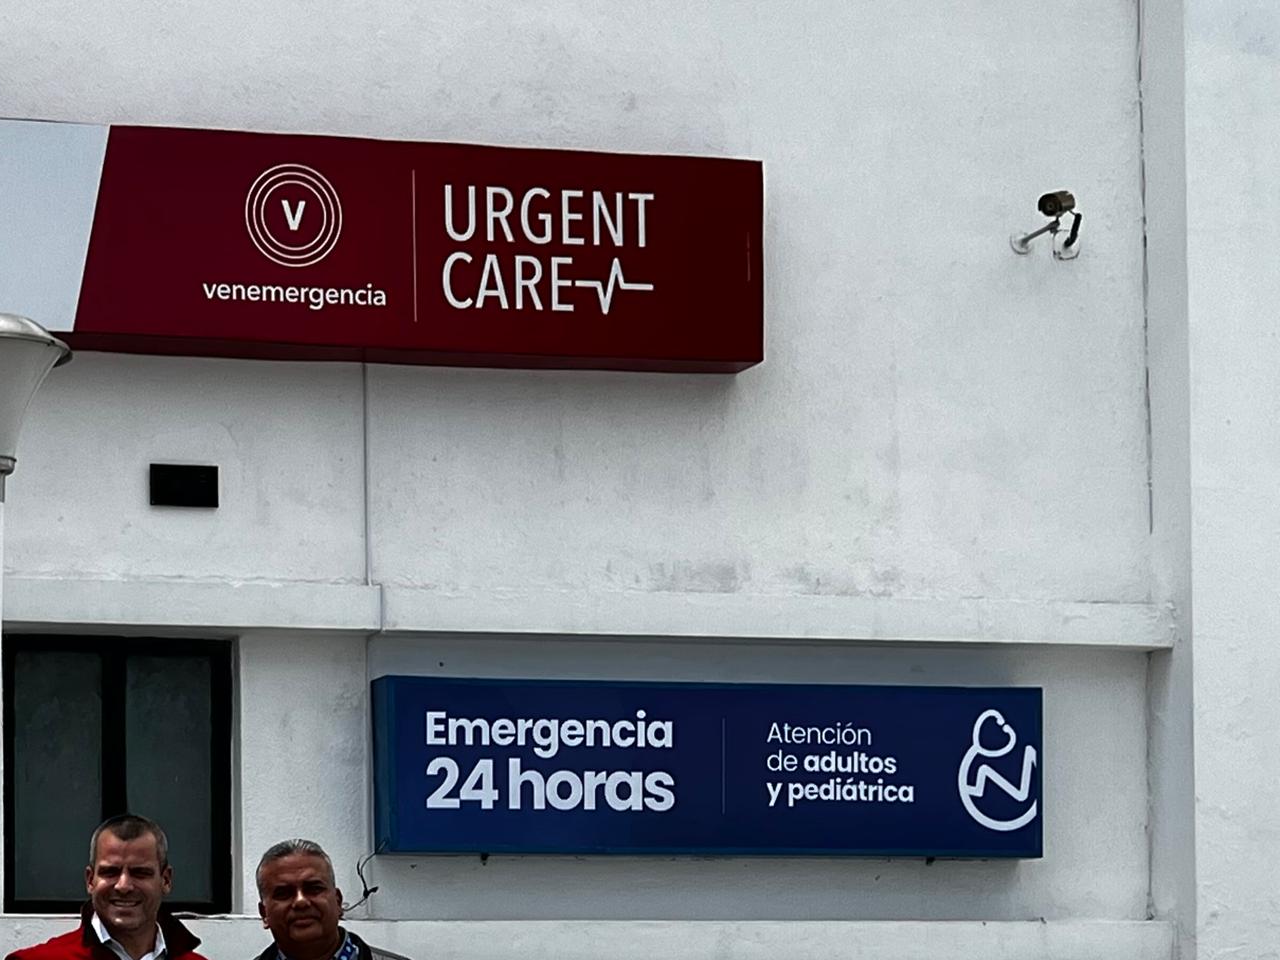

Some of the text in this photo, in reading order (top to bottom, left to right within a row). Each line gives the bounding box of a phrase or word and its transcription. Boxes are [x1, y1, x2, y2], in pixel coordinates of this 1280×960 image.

[444, 184, 655, 248] URGENT
[202, 283, 387, 311] venemergencia
[442, 251, 575, 312] CARE
[426, 709, 673, 759] Emergencia
[766, 722, 872, 746] Atención
[766, 749, 897, 774] de adultos
[426, 757, 675, 812] 24 horas
[766, 777, 914, 807] y pediátrica
